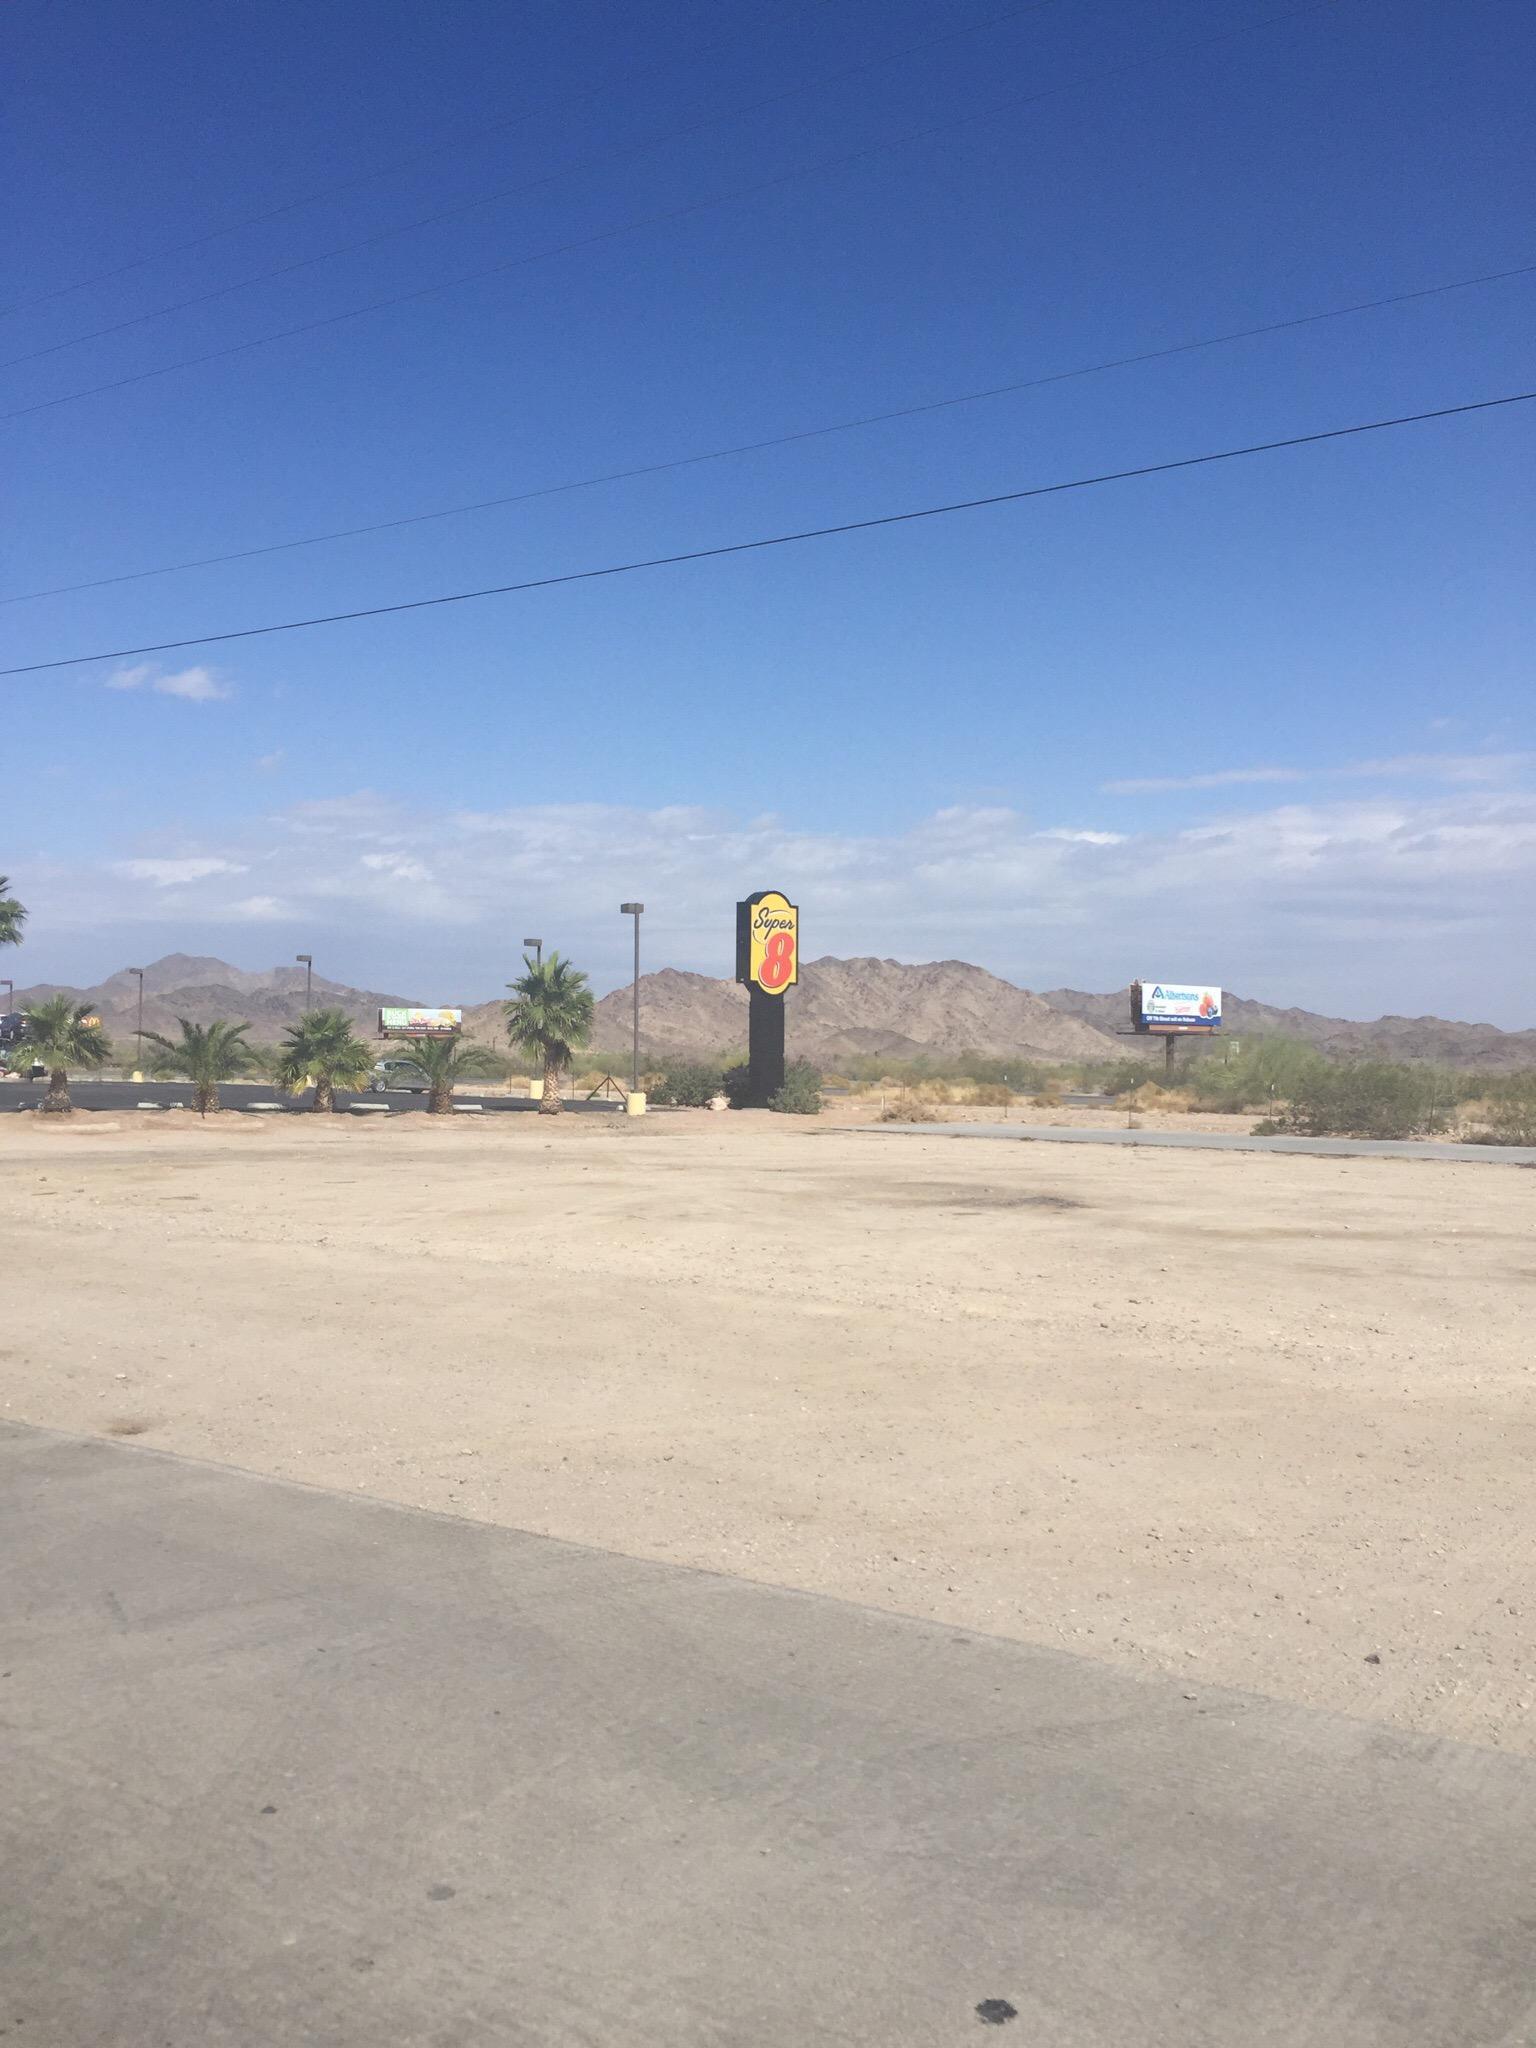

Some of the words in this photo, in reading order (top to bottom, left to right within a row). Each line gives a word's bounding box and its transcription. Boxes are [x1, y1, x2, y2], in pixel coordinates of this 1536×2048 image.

[753, 906, 795, 939] Super
[758, 932, 794, 988] 8
[1165, 989, 1199, 1001] Albertsons
